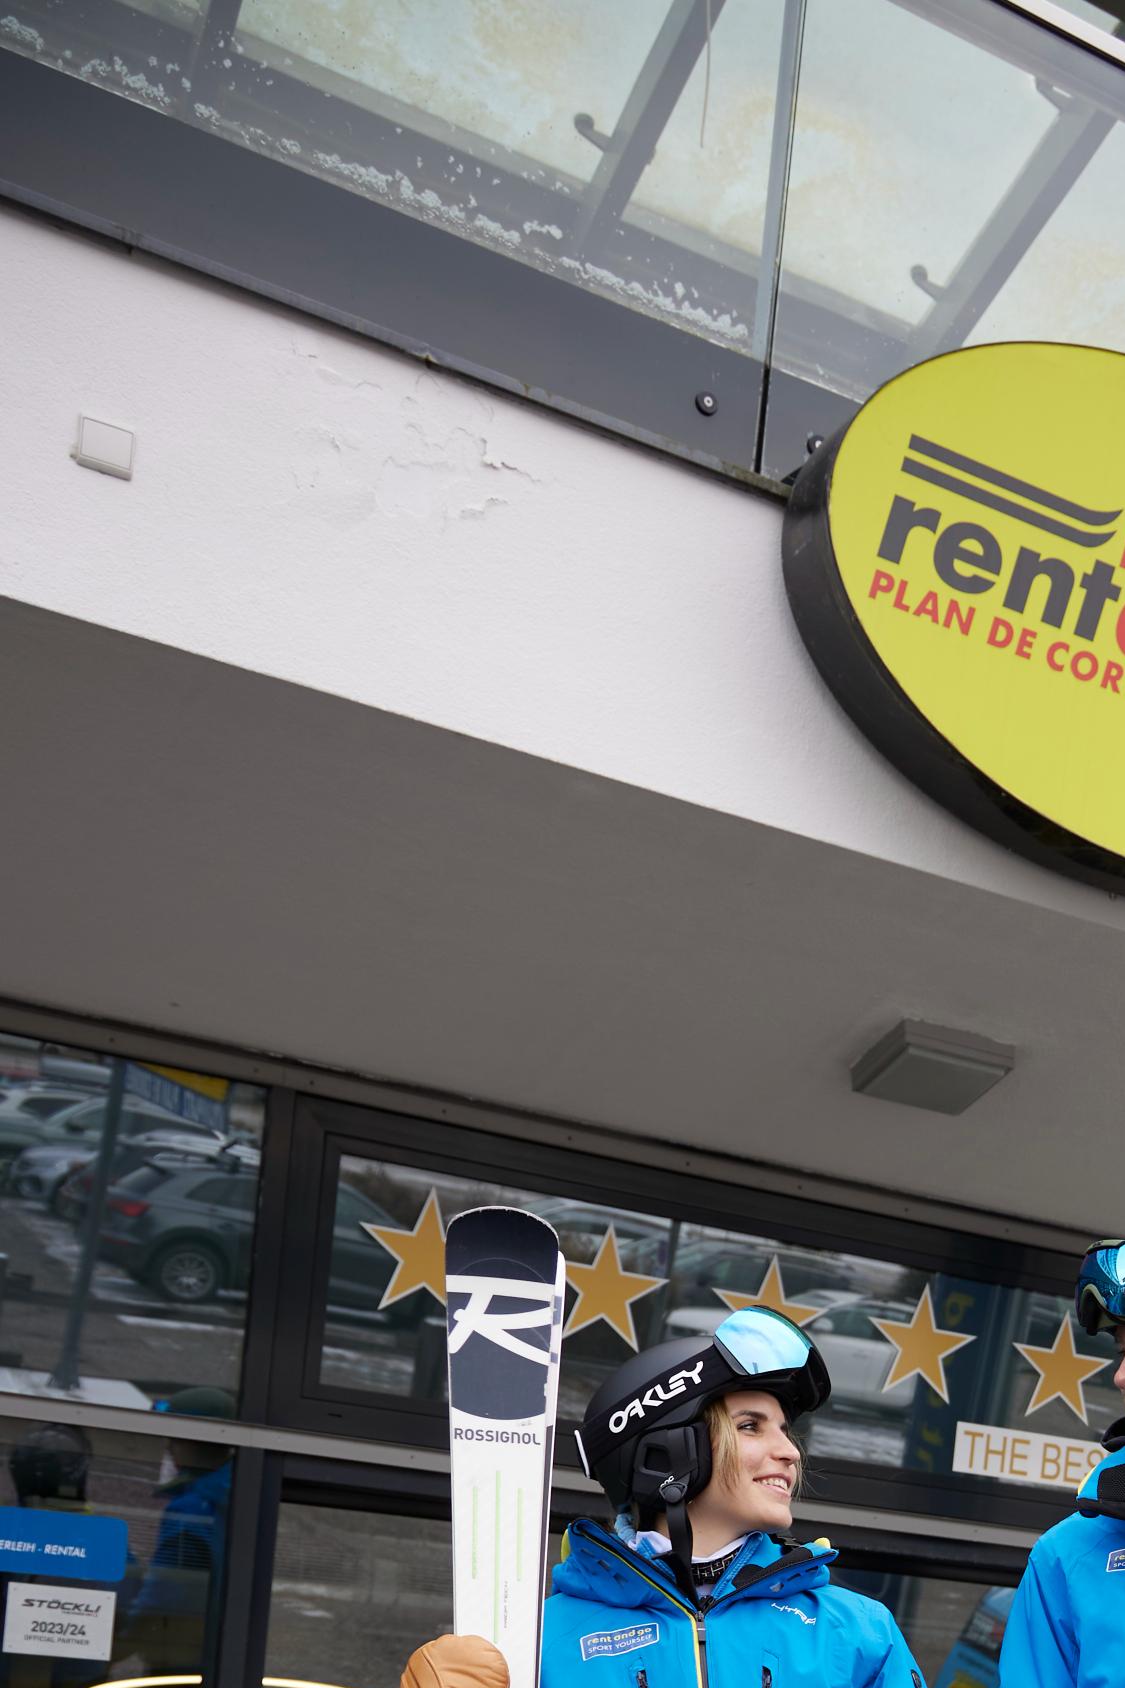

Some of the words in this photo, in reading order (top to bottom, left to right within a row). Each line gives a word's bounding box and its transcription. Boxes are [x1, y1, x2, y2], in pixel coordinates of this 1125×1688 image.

[868, 569, 977, 636] PLAN
[988, 616, 1034, 661] DE
[608, 1361, 704, 1434] OAKLEY
[453, 1428, 541, 1446] ROSSIGNOL
[964, 1430, 1031, 1476] THE
[44, 1544, 87, 1558] RENTAL
[21, 1598, 101, 1613] STÖCKLI
[31, 1620, 86, 1637] 2023/24
[587, 1636, 612, 1646] rent
[614, 1629, 635, 1640] and
[637, 1627, 652, 1636] go
[24, 1633, 55, 1644] OFFICIAL
[57, 1637, 90, 1646] PARTNER
[588, 1645, 612, 1654] SPORT
[615, 1634, 652, 1649] YOURSELF
